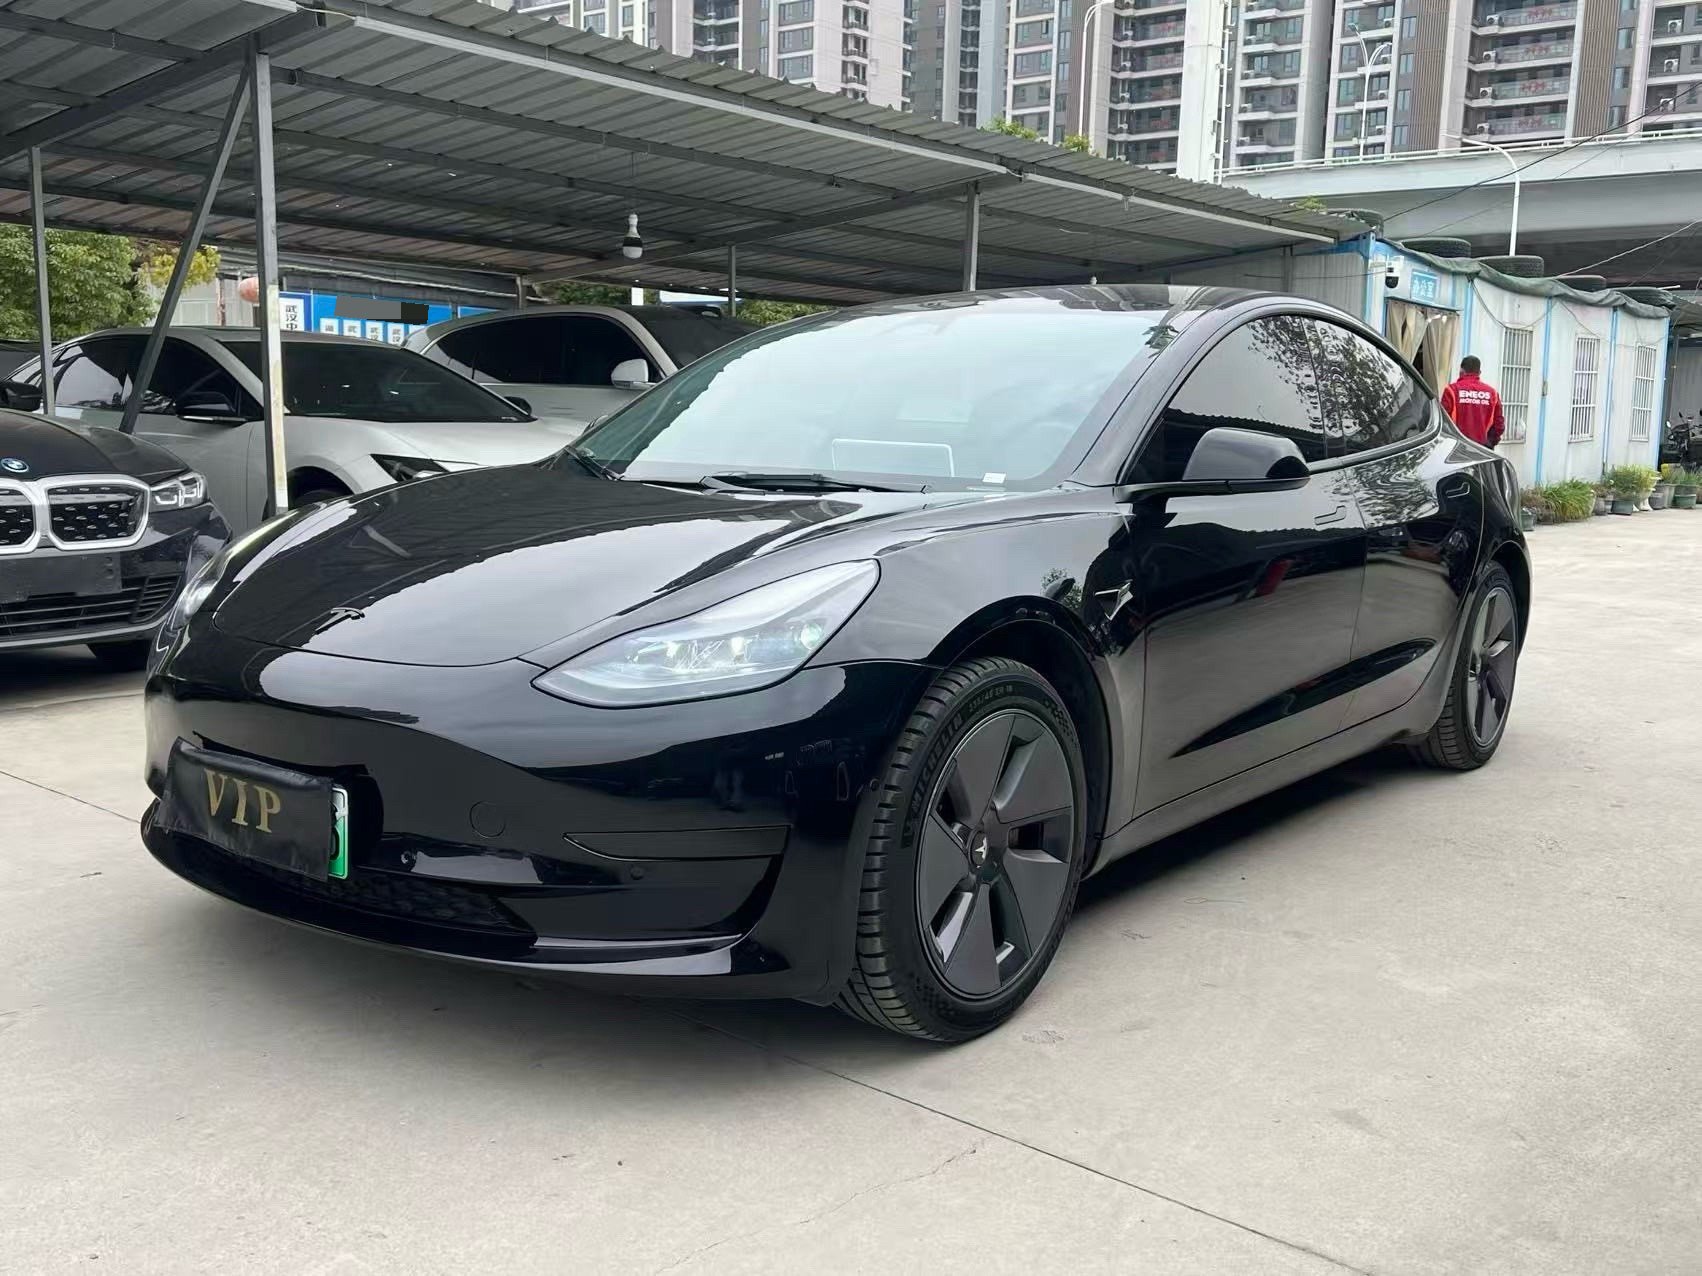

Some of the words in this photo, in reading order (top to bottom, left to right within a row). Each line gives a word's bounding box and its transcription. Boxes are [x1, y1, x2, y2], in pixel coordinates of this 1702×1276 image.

[1459, 390, 1491, 400] ENEOS
[1459, 397, 1481, 405] MOTOR
[912, 713, 964, 814] MICHELIN
[204, 768, 281, 833] VIP
